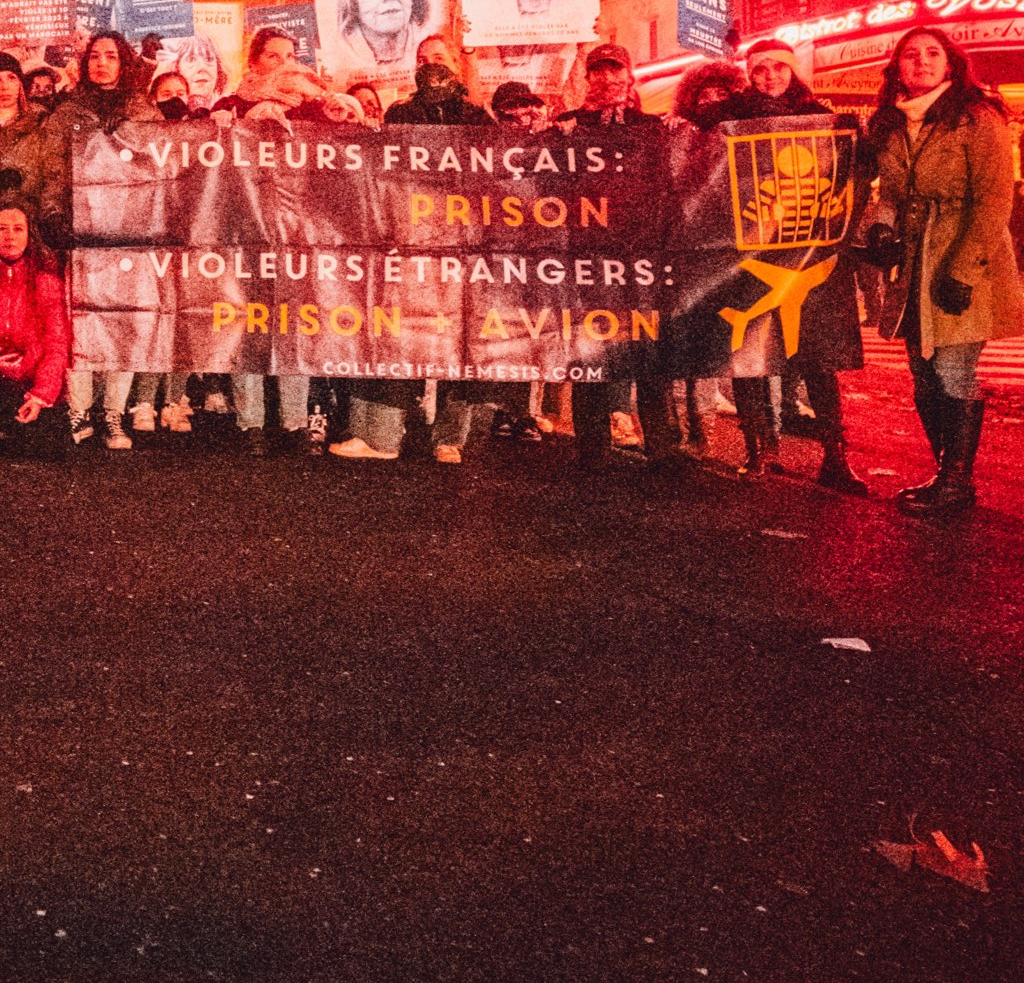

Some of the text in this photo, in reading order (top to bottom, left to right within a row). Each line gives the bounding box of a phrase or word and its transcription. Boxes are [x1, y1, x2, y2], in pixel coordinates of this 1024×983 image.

[774, 11, 863, 46] Bistrot
[866, 1, 917, 24] des
[147, 141, 624, 180] VIOLEURS FRANÇAIS:
[410, 194, 609, 229] PRISON
[148, 248, 674, 286] VIOLEURS ÉTRANGERS:
[212, 302, 403, 337] PRISON
[478, 307, 660, 342] AVION
[322, 361, 603, 381] COLLECTIF-NEMESIS.COM
